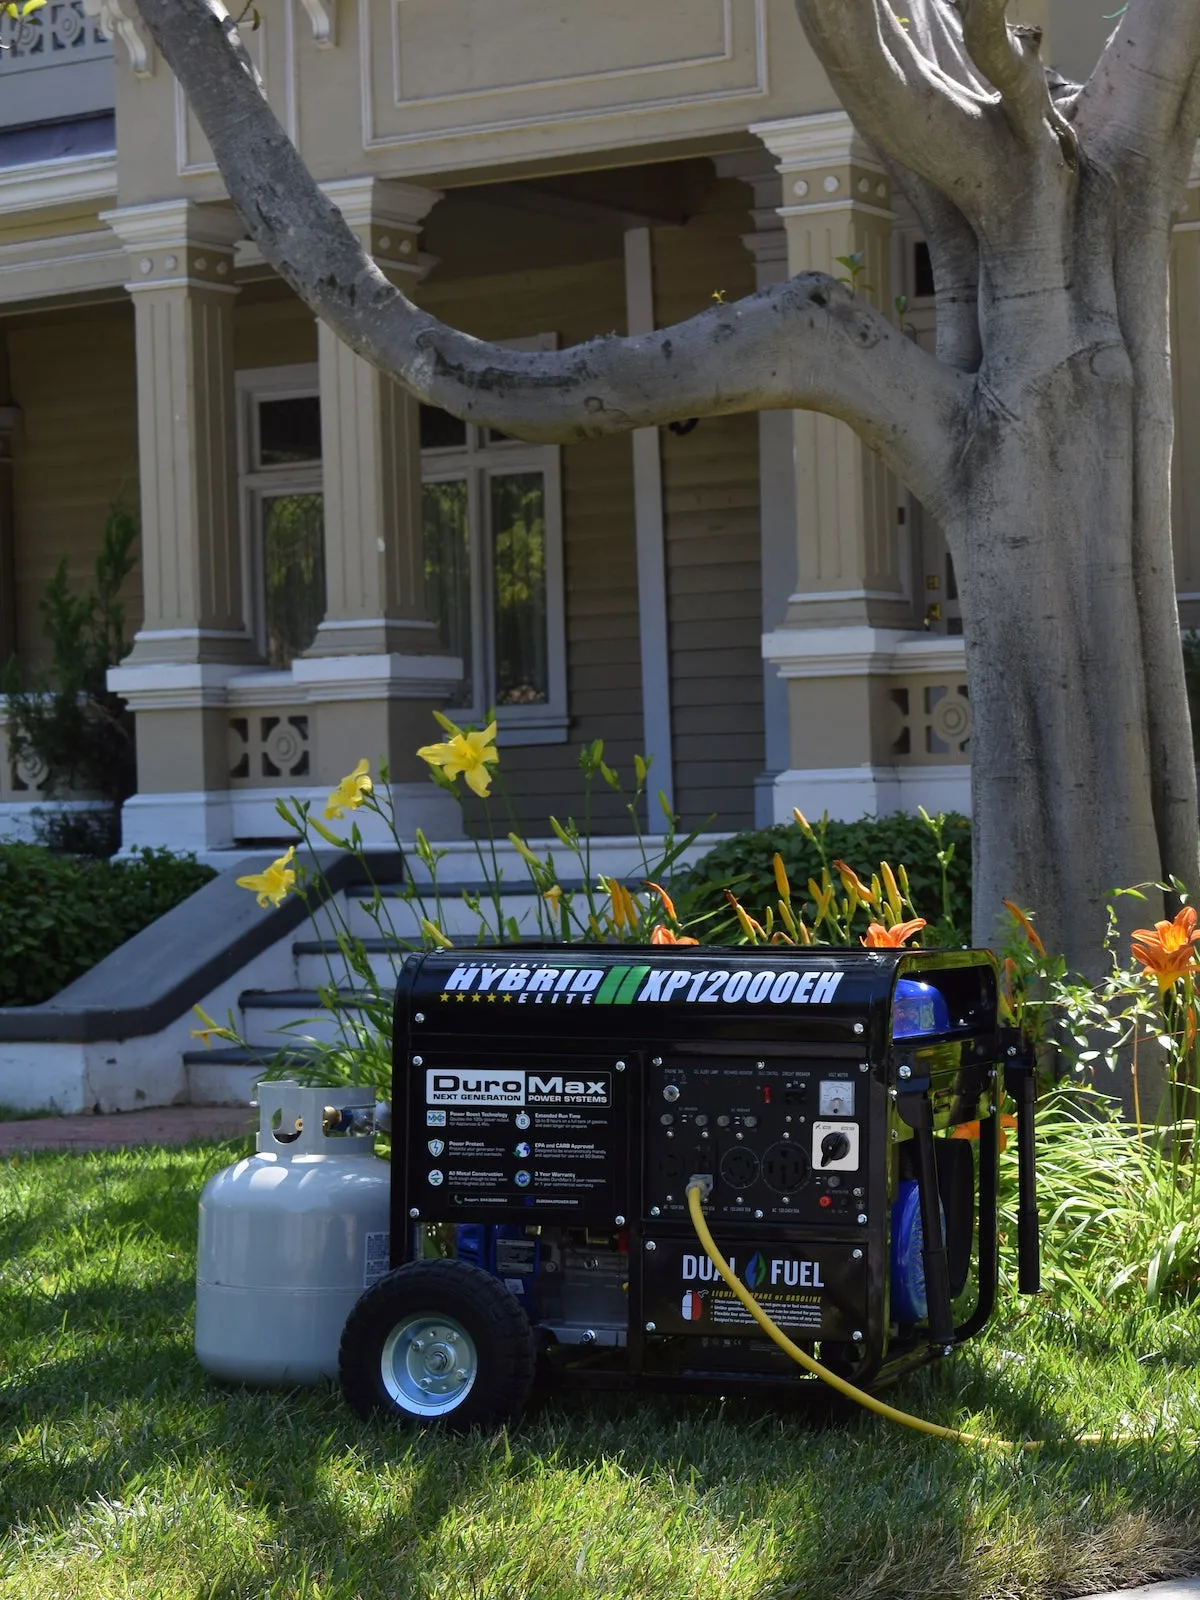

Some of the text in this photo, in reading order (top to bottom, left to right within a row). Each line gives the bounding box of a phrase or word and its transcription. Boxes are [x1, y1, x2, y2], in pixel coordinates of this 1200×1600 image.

[443, 967, 845, 1004] HYBRID XP12000EH
[517, 993, 593, 1005] ELITE
[433, 1093, 521, 1102] NEXT GENERATION
[528, 1095, 608, 1104] POWER SYSTEMS
[481, 1111, 509, 1119] Technology
[551, 1171, 577, 1180] Warranty
[771, 1259, 825, 1287] FUEL
[785, 1294, 822, 1304] GASOLINE
